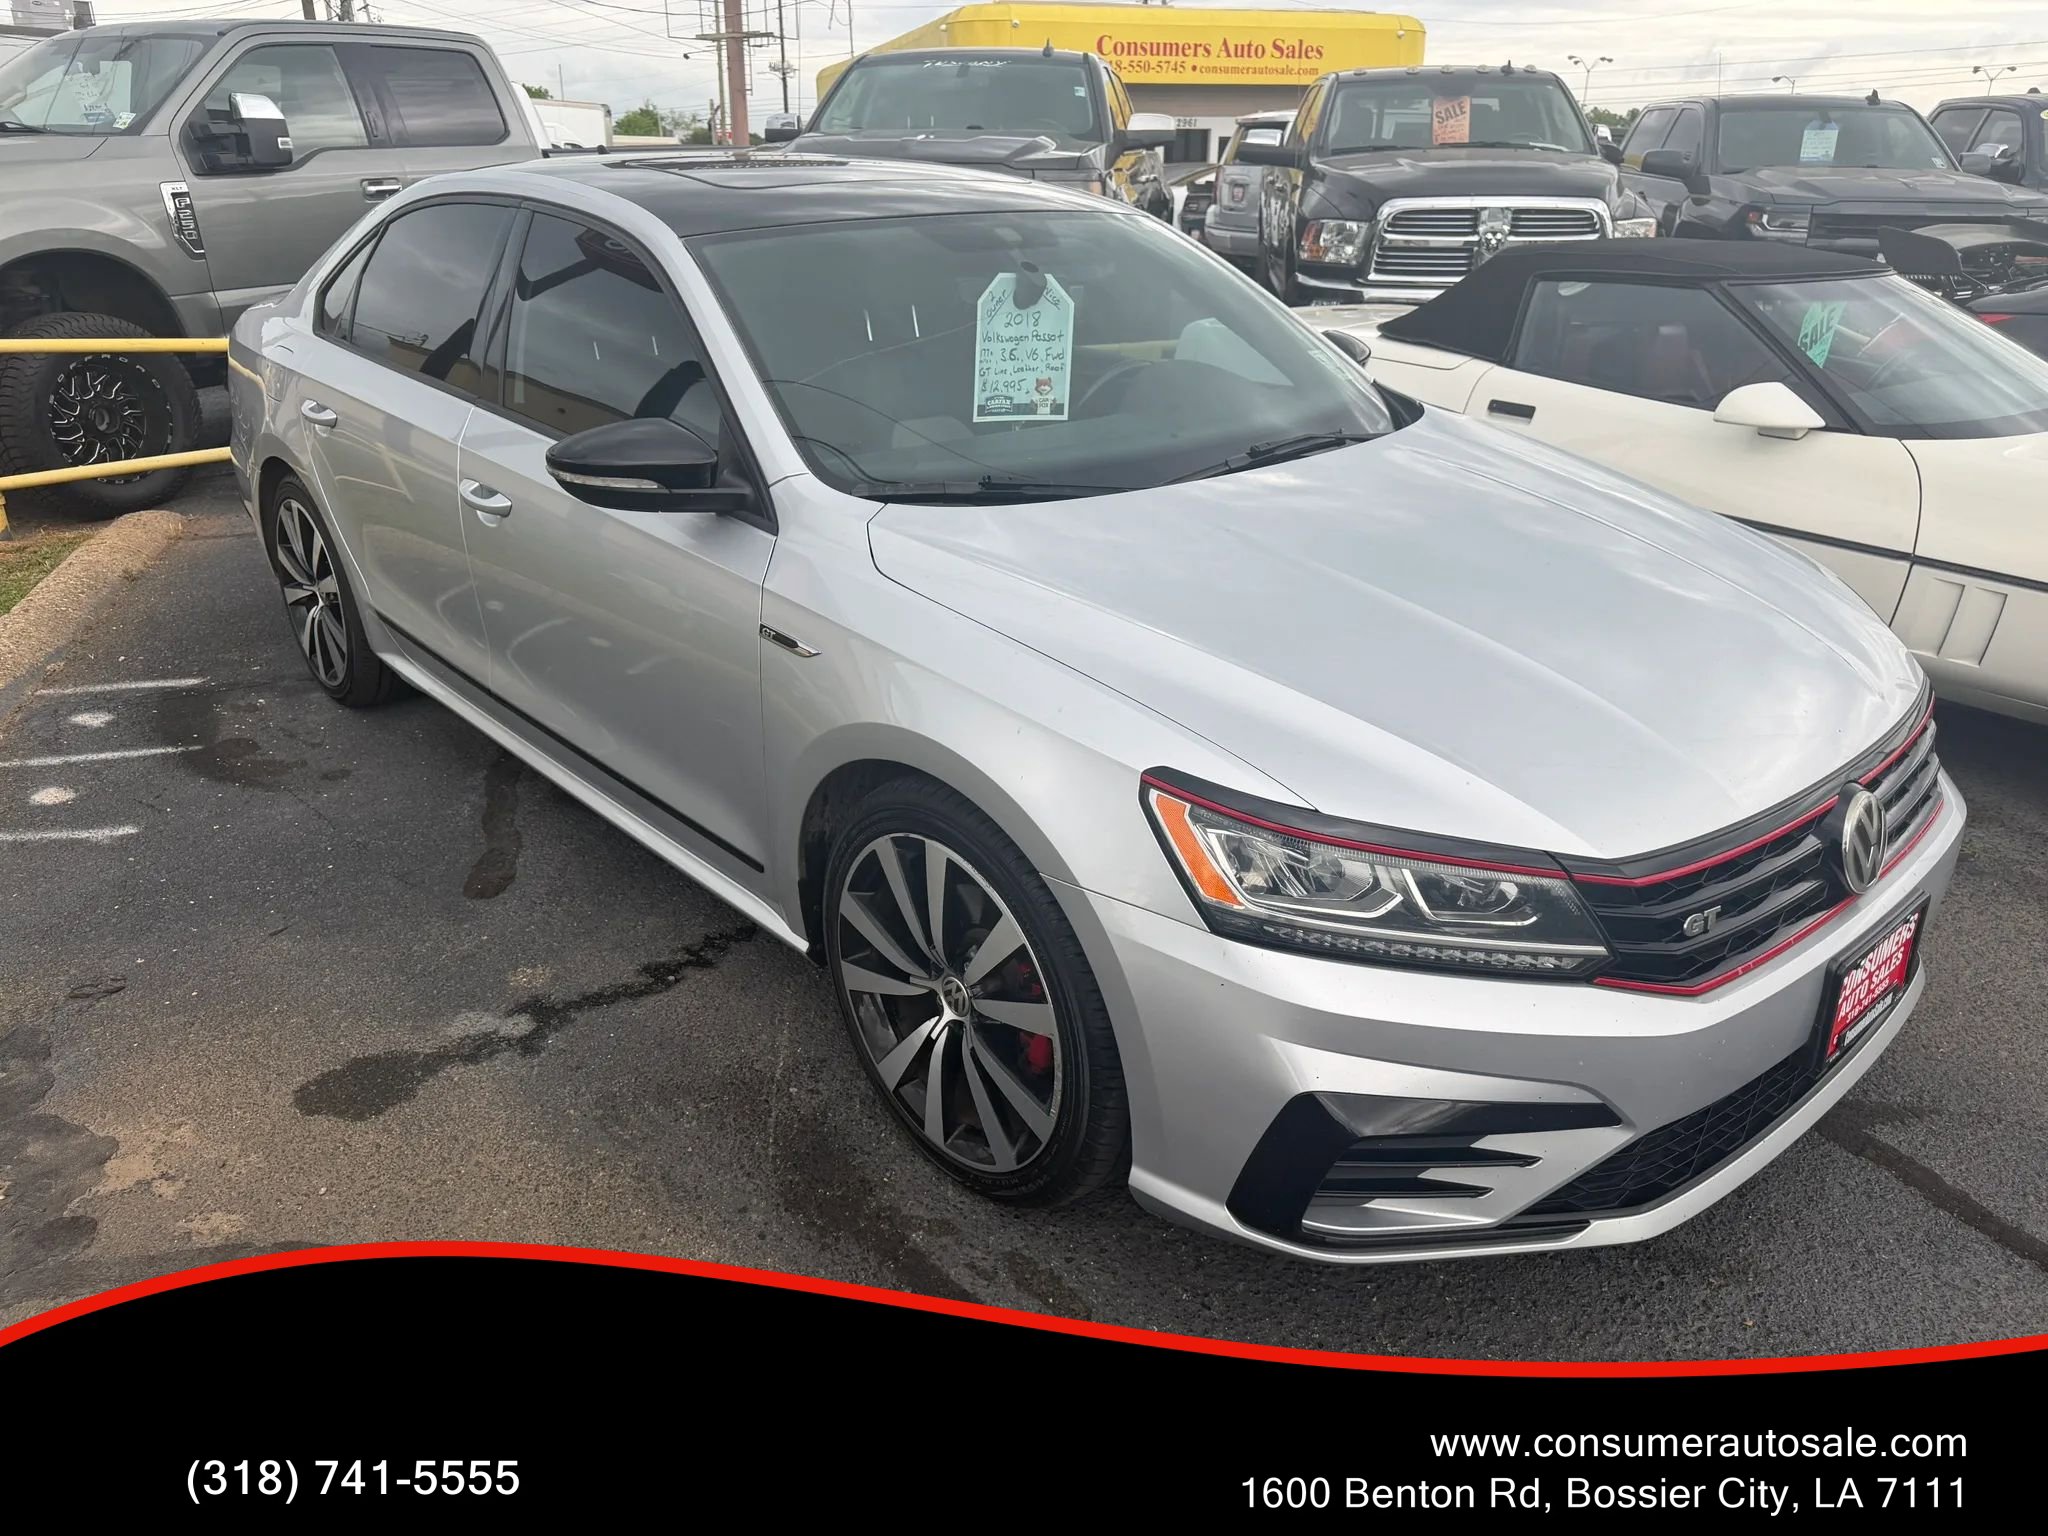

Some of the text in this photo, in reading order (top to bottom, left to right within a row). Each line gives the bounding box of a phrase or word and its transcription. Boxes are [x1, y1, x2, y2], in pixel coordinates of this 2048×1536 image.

[1096, 34, 1325, 60] Consumers Auto Sales
[1199, 64, 1319, 76] consumerautosale.com
[1435, 101, 1467, 125] SALE
[1004, 311, 1042, 328] 2018
[1799, 306, 1837, 352] SALE
[982, 329, 1065, 346] Volkswagen Passat
[1045, 346, 1065, 361] Fwd
[979, 367, 991, 377] GT
[1683, 905, 1722, 937] GT
[1838, 912, 1920, 1006] CONSUMERS
[1837, 946, 1905, 1022] AUTO SALES
